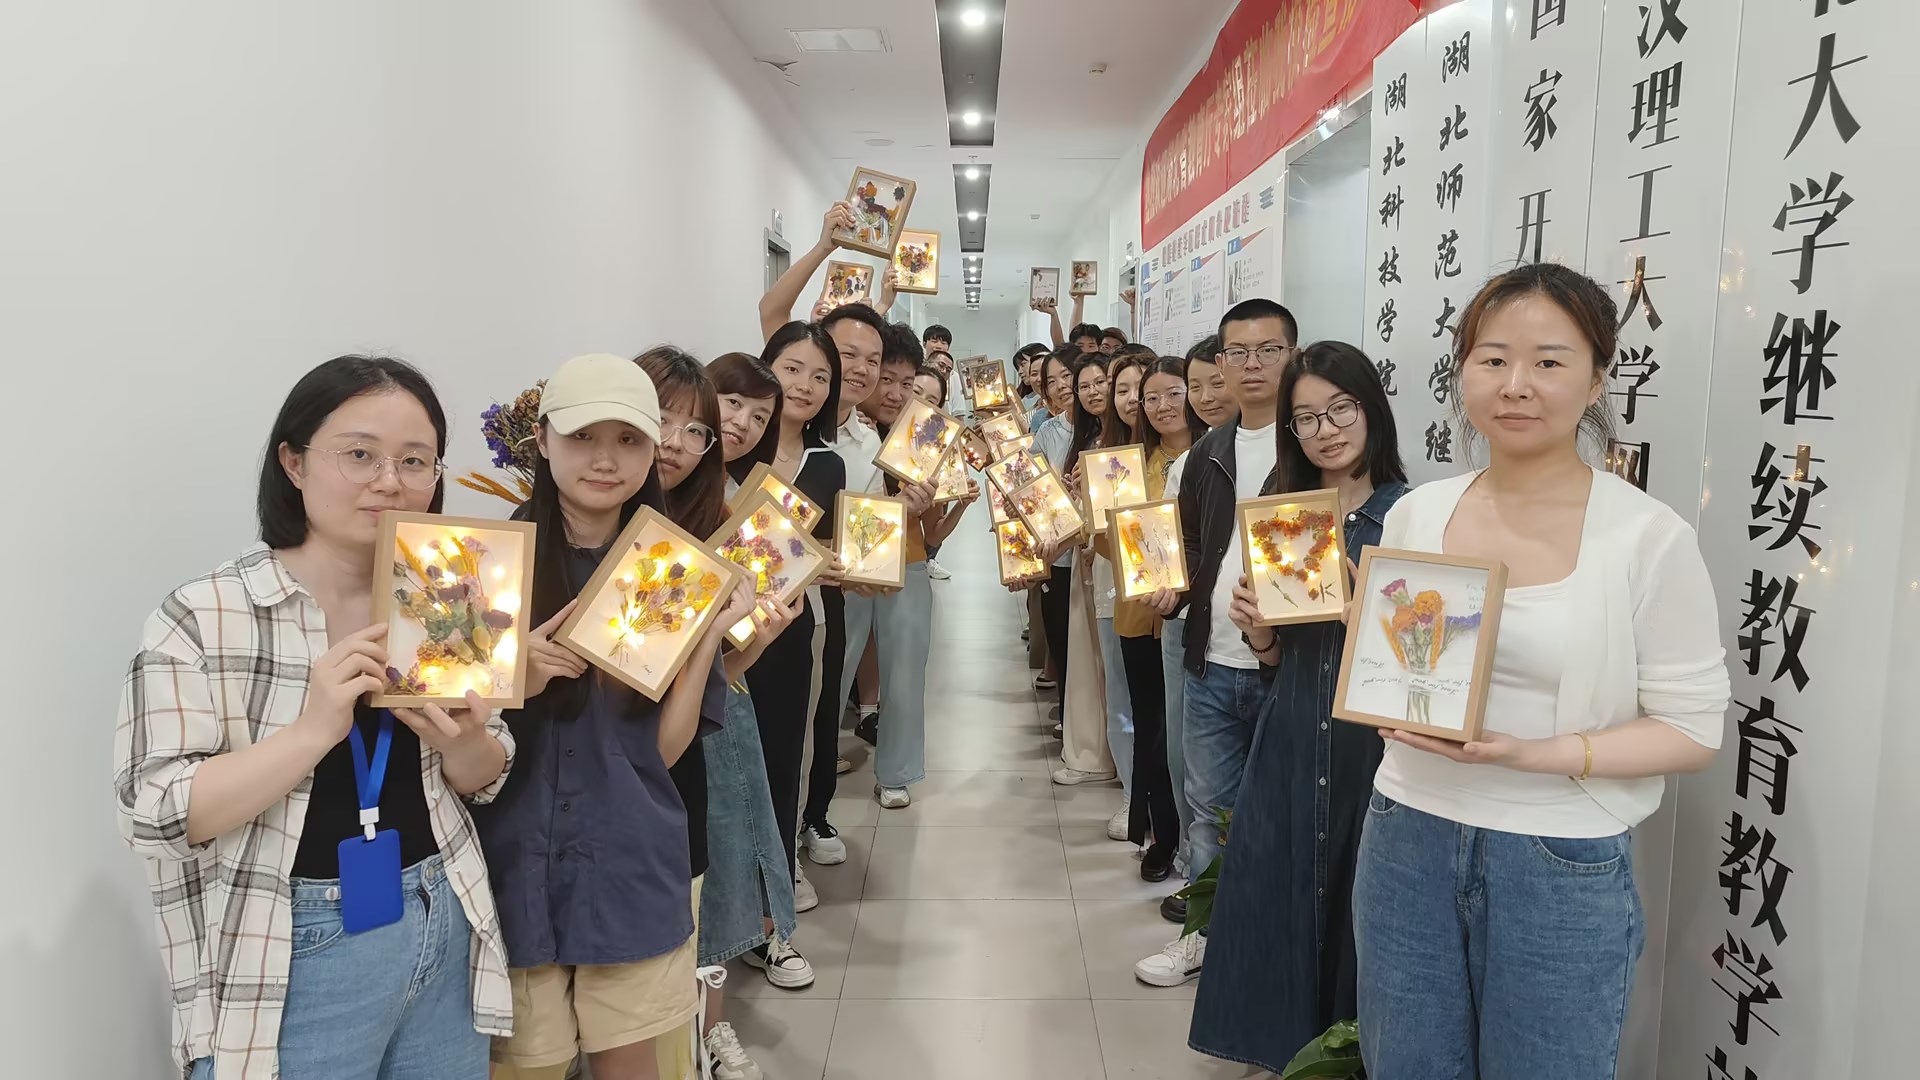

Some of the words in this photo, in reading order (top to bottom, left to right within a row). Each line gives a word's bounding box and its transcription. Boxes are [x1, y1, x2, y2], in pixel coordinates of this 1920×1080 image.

[1376, 72, 1408, 396] 湖北科技学院
[1425, 31, 1471, 463] 湖北师范大学继
[1706, 0, 1868, 1080] 大学继续教育教学
